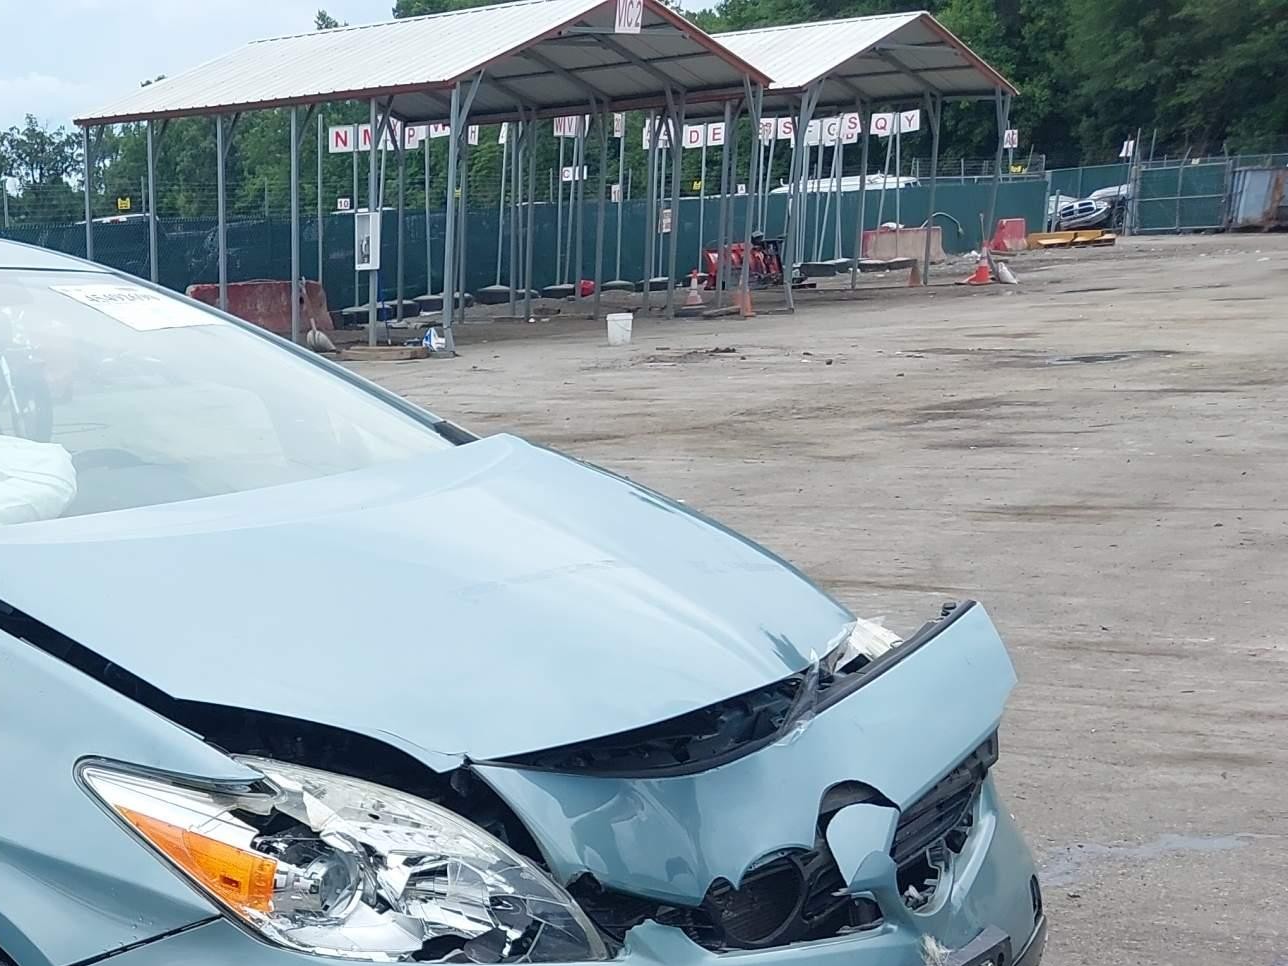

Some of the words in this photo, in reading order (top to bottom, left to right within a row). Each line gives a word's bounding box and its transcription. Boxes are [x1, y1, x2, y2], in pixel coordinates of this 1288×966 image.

[618, 0, 633, 27] VIC
[634, 0, 642, 27] 2
[782, 121, 793, 135] S
[848, 116, 858, 130] S
[875, 117, 887, 131] Q
[905, 114, 915, 128] Y
[335, 130, 348, 148] N
[407, 127, 416, 145] P
[689, 129, 700, 144] D
[712, 127, 722, 142] E
[338, 199, 349, 208] 10
